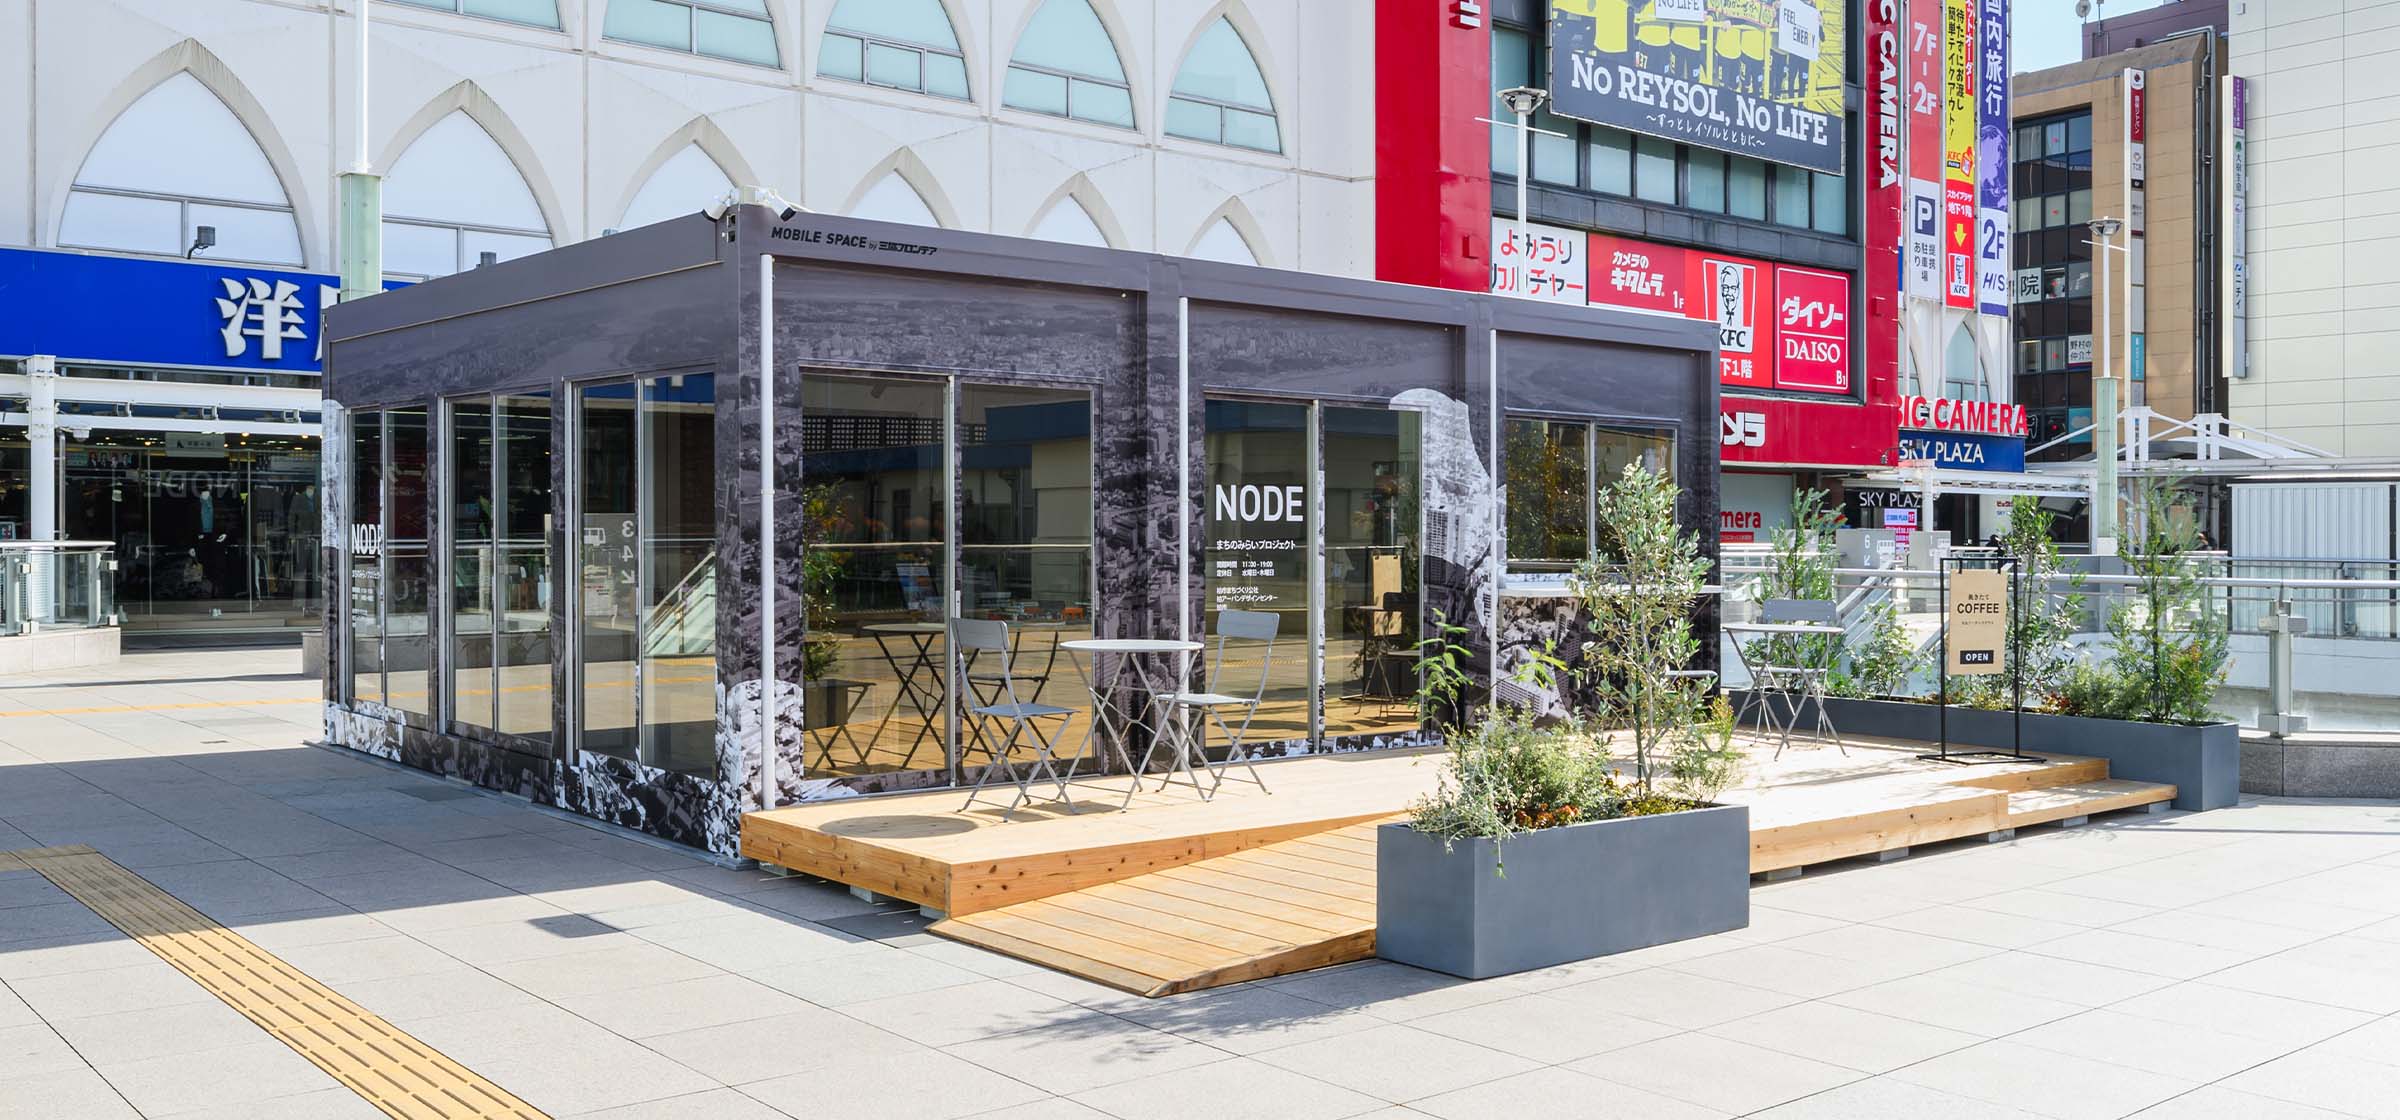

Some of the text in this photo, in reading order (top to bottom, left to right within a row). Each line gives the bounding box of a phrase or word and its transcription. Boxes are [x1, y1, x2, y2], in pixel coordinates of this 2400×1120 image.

[1676, 0, 1700, 11] LIFE
[1784, 8, 1797, 26] FEEL
[1914, 22, 1937, 115] 7F 2F
[1956, 8, 1965, 111] 待たずにお渡し
[1617, 65, 1730, 127] REYSOL,
[1776, 105, 1829, 146] LIFE
[1880, 30, 1897, 189] CAMERA
[1917, 200, 1932, 231] P
[771, 226, 822, 244] MOBILE
[826, 232, 868, 249] SPACE
[1982, 219, 2005, 260] 2F
[1611, 250, 1650, 269] カメラの
[1914, 242, 1921, 267] あり
[1610, 267, 1662, 297] キタムラ
[1953, 285, 1967, 295] KFC
[1672, 290, 1685, 310] 1F
[1781, 295, 1844, 329] ダイソー
[1720, 329, 1746, 348] KFC
[1785, 338, 1841, 364] DAISO
[1836, 370, 1846, 385] B1
[1720, 411, 1766, 447] メラ
[1934, 398, 2029, 436] CAMERA
[1899, 439, 1985, 464] SKY PLAZA
[1216, 484, 1304, 522] NODE
[1859, 491, 1885, 507] SKY
[1216, 540, 1296, 550] まちのみらいプロジェクト
[1864, 534, 1871, 549] 6
[1957, 603, 1999, 614] COFFEE
[1965, 653, 1989, 662] OPEN
